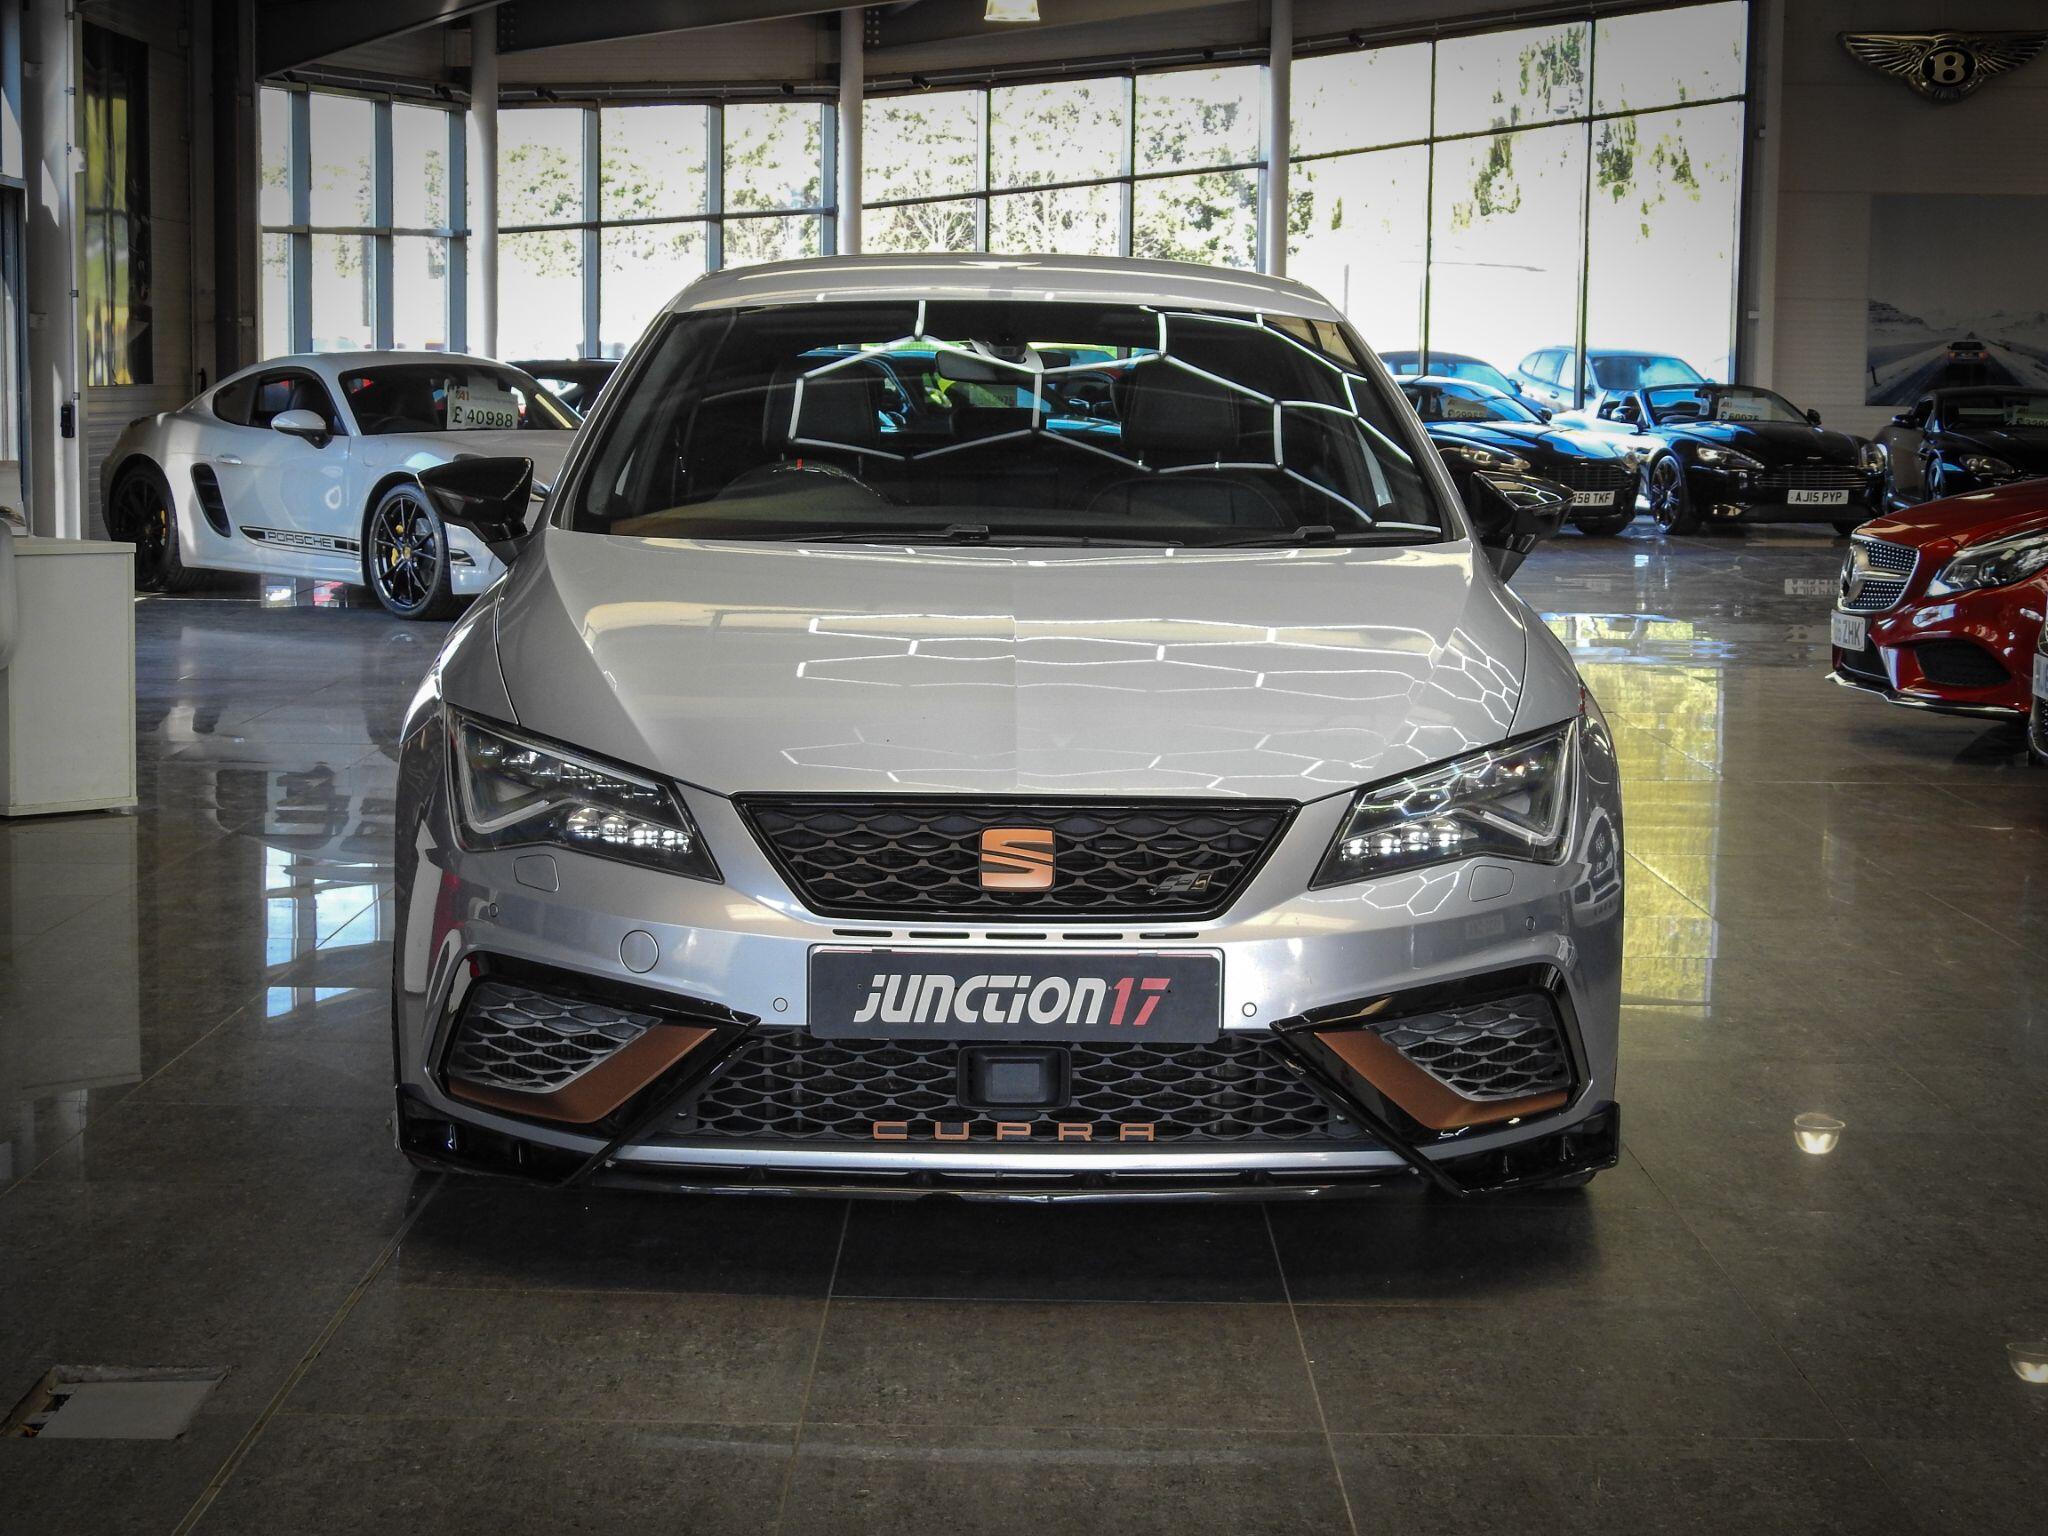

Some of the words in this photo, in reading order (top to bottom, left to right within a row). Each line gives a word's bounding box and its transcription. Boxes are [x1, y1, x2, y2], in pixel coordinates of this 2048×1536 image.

[1933, 51, 1966, 84] B
[1593, 492, 1612, 504] TKF
[1821, 491, 1842, 503] PYP
[267, 531, 332, 548] PORSCHE
[1842, 619, 1861, 646] ZHK
[872, 1121, 1155, 1142] CUPRA
